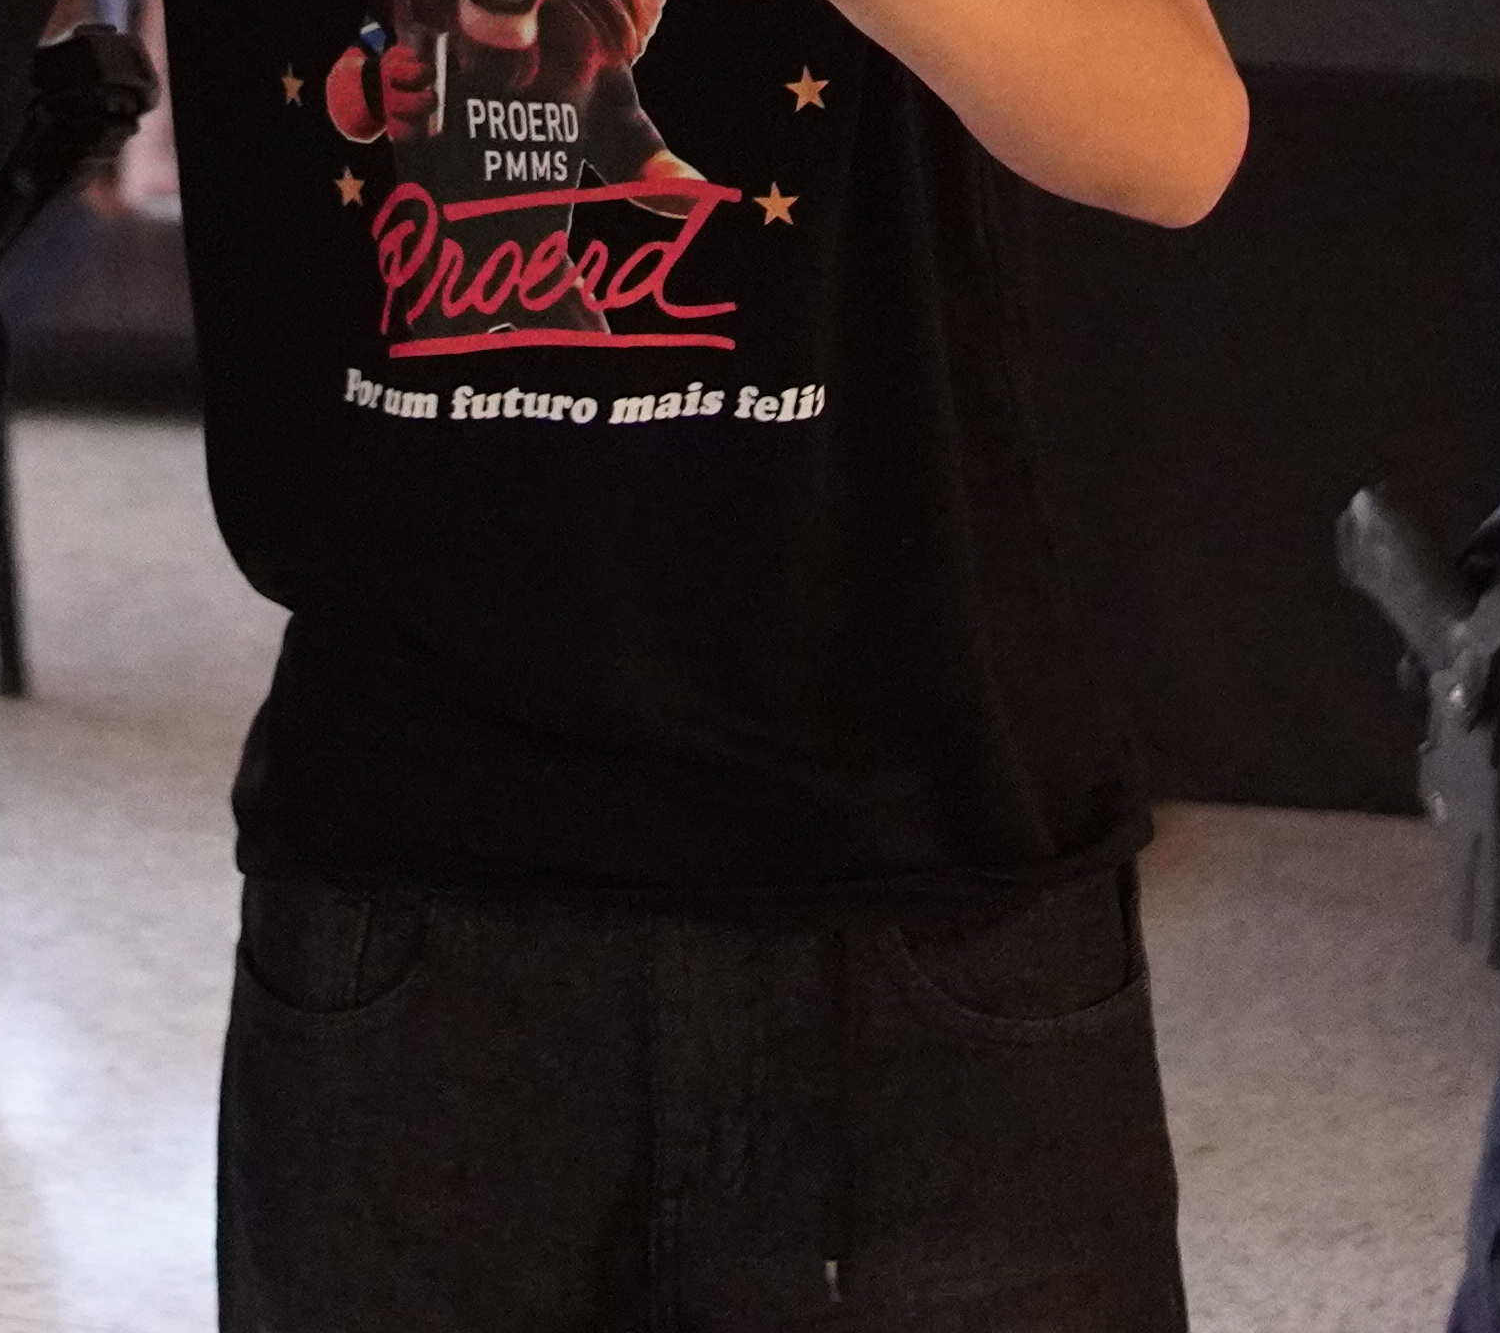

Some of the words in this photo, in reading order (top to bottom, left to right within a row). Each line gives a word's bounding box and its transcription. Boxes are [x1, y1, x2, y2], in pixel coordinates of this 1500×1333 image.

[467, 98, 579, 143] PROERD
[485, 150, 568, 182] PMMS
[371, 181, 741, 335] Proerd
[345, 367, 384, 409] Por
[383, 387, 439, 419] um
[450, 384, 598, 424] futuro
[608, 381, 725, 425] mais
